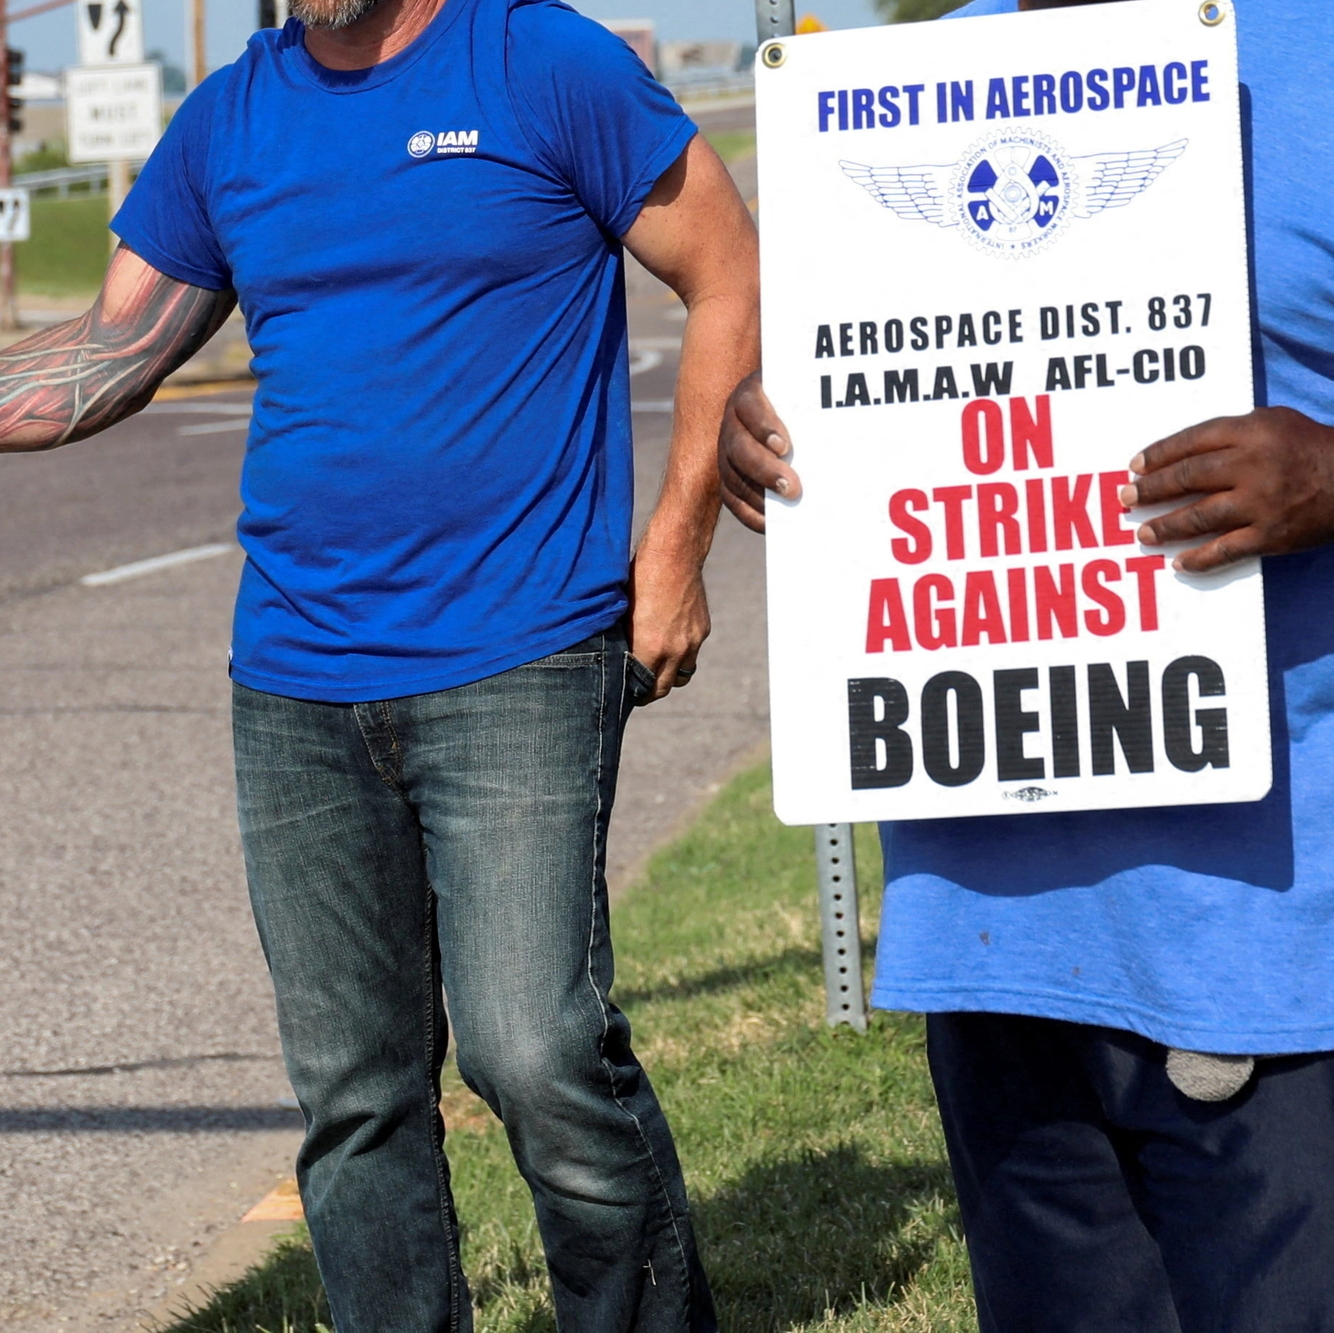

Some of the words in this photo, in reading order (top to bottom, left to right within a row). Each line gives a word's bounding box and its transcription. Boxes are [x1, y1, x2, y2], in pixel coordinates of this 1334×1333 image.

[818, 83, 926, 132] FIRST
[936, 80, 974, 123] IN
[985, 59, 1210, 120] AEROSPACE
[436, 129, 479, 146] IAM
[815, 309, 1023, 359] AEROSPACE
[1040, 301, 1133, 341] DIST.
[1148, 293, 1211, 331] 837
[820, 361, 1013, 409] I.A.M.A.W
[1045, 345, 1206, 392] AFL-CIO
[961, 394, 1054, 476] ON
[889, 470, 1135, 565] STRIKE
[865, 554, 1166, 654] AGAINST
[847, 655, 1230, 791] BOEING
